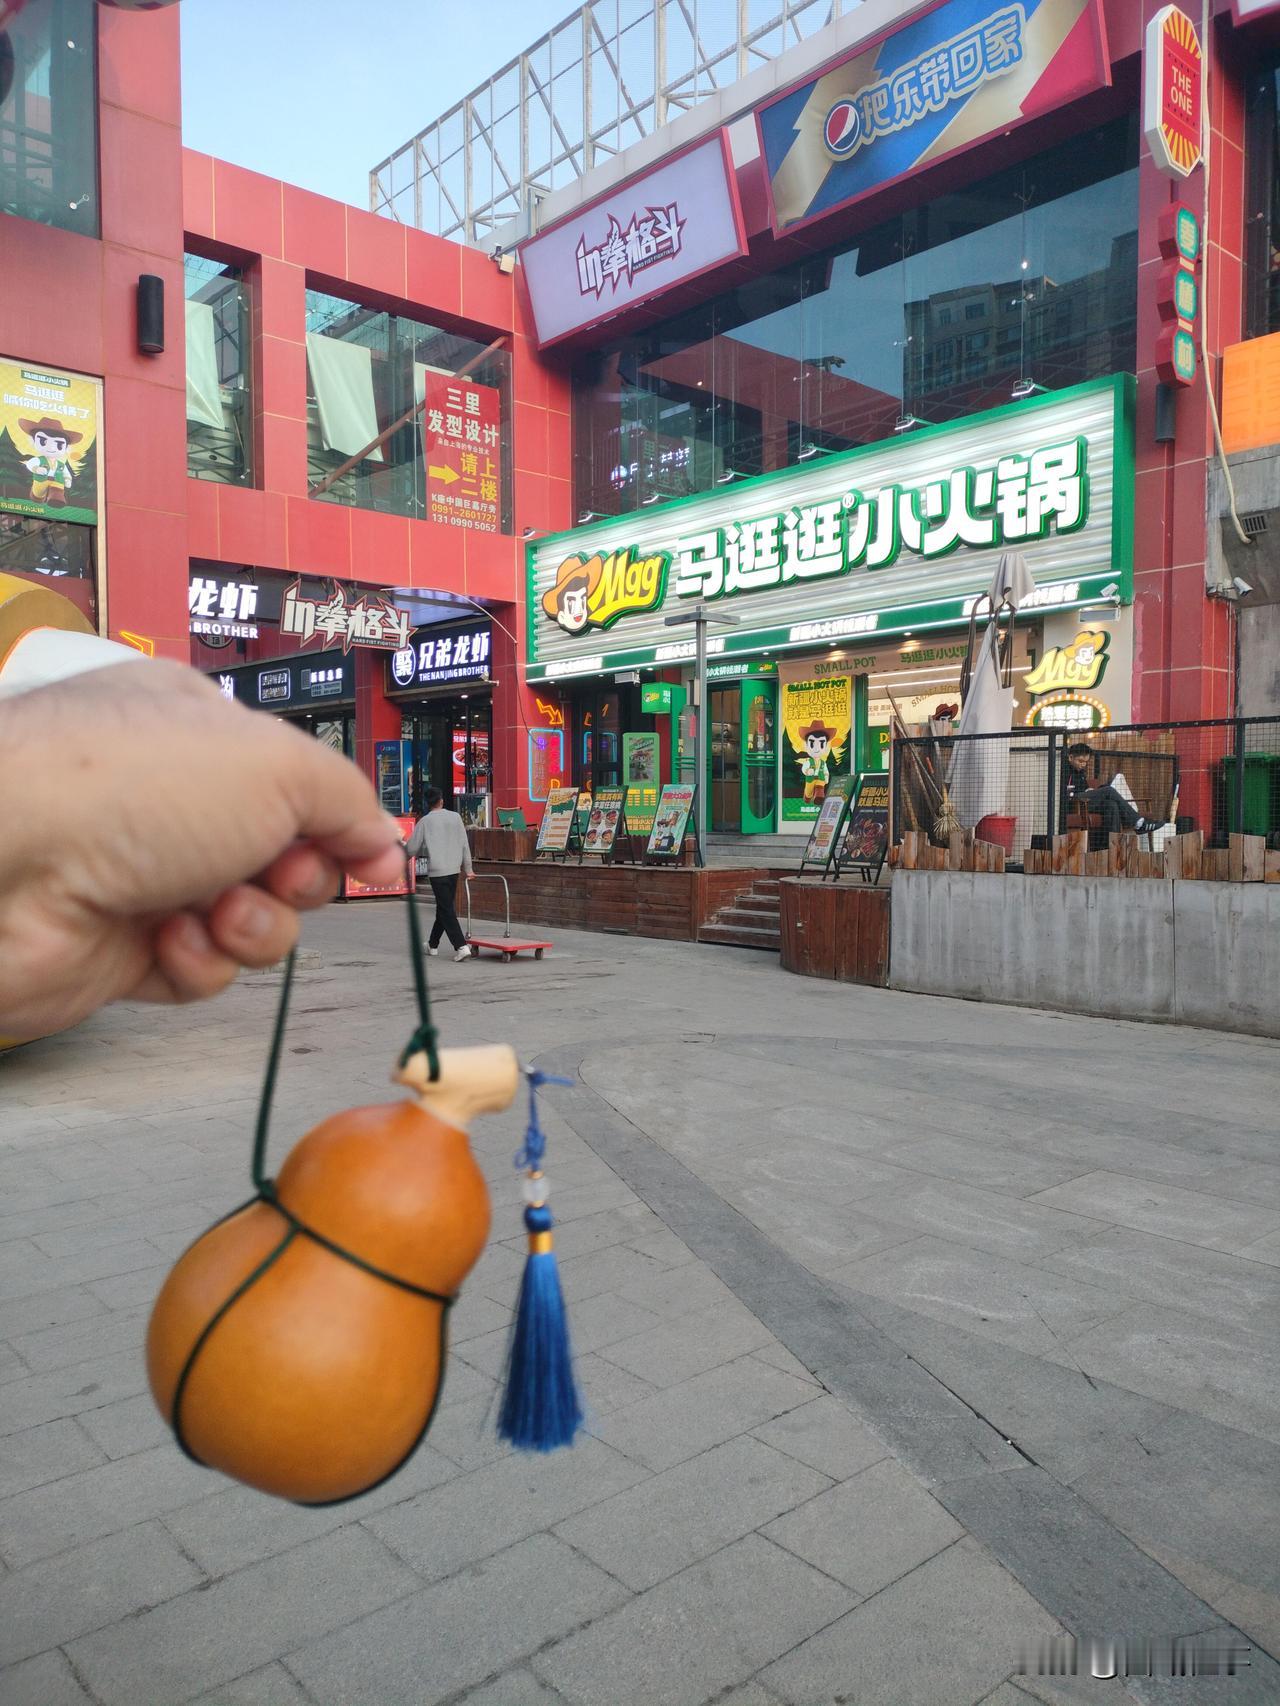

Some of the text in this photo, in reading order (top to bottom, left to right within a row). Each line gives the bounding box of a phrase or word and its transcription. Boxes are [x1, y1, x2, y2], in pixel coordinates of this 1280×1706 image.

[861, 13, 1019, 134] 把乐带回家
[1171, 65, 1193, 96] THE
[1170, 86, 1193, 116] ONE
[446, 387, 481, 416] 三里
[428, 408, 499, 448] 发型设计
[460, 452, 497, 479] 请上
[461, 477, 497, 502] 二楼
[431, 503, 497, 523] 0991-2601727
[432, 513, 497, 533] 131 0990 5052
[188, 577, 259, 621] 龙虾
[588, 548, 668, 630] Mgg
[193, 622, 259, 639] BROTHER
[418, 631, 490, 670] 兄弟龙虾
[459, 665, 489, 677] BROTHER
[814, 656, 876, 675] SMALL POT
[787, 678, 847, 692] SMALL HOT POT
[787, 688, 847, 706] 新疆小火锅
[786, 703, 847, 720] 就是马逛逛
